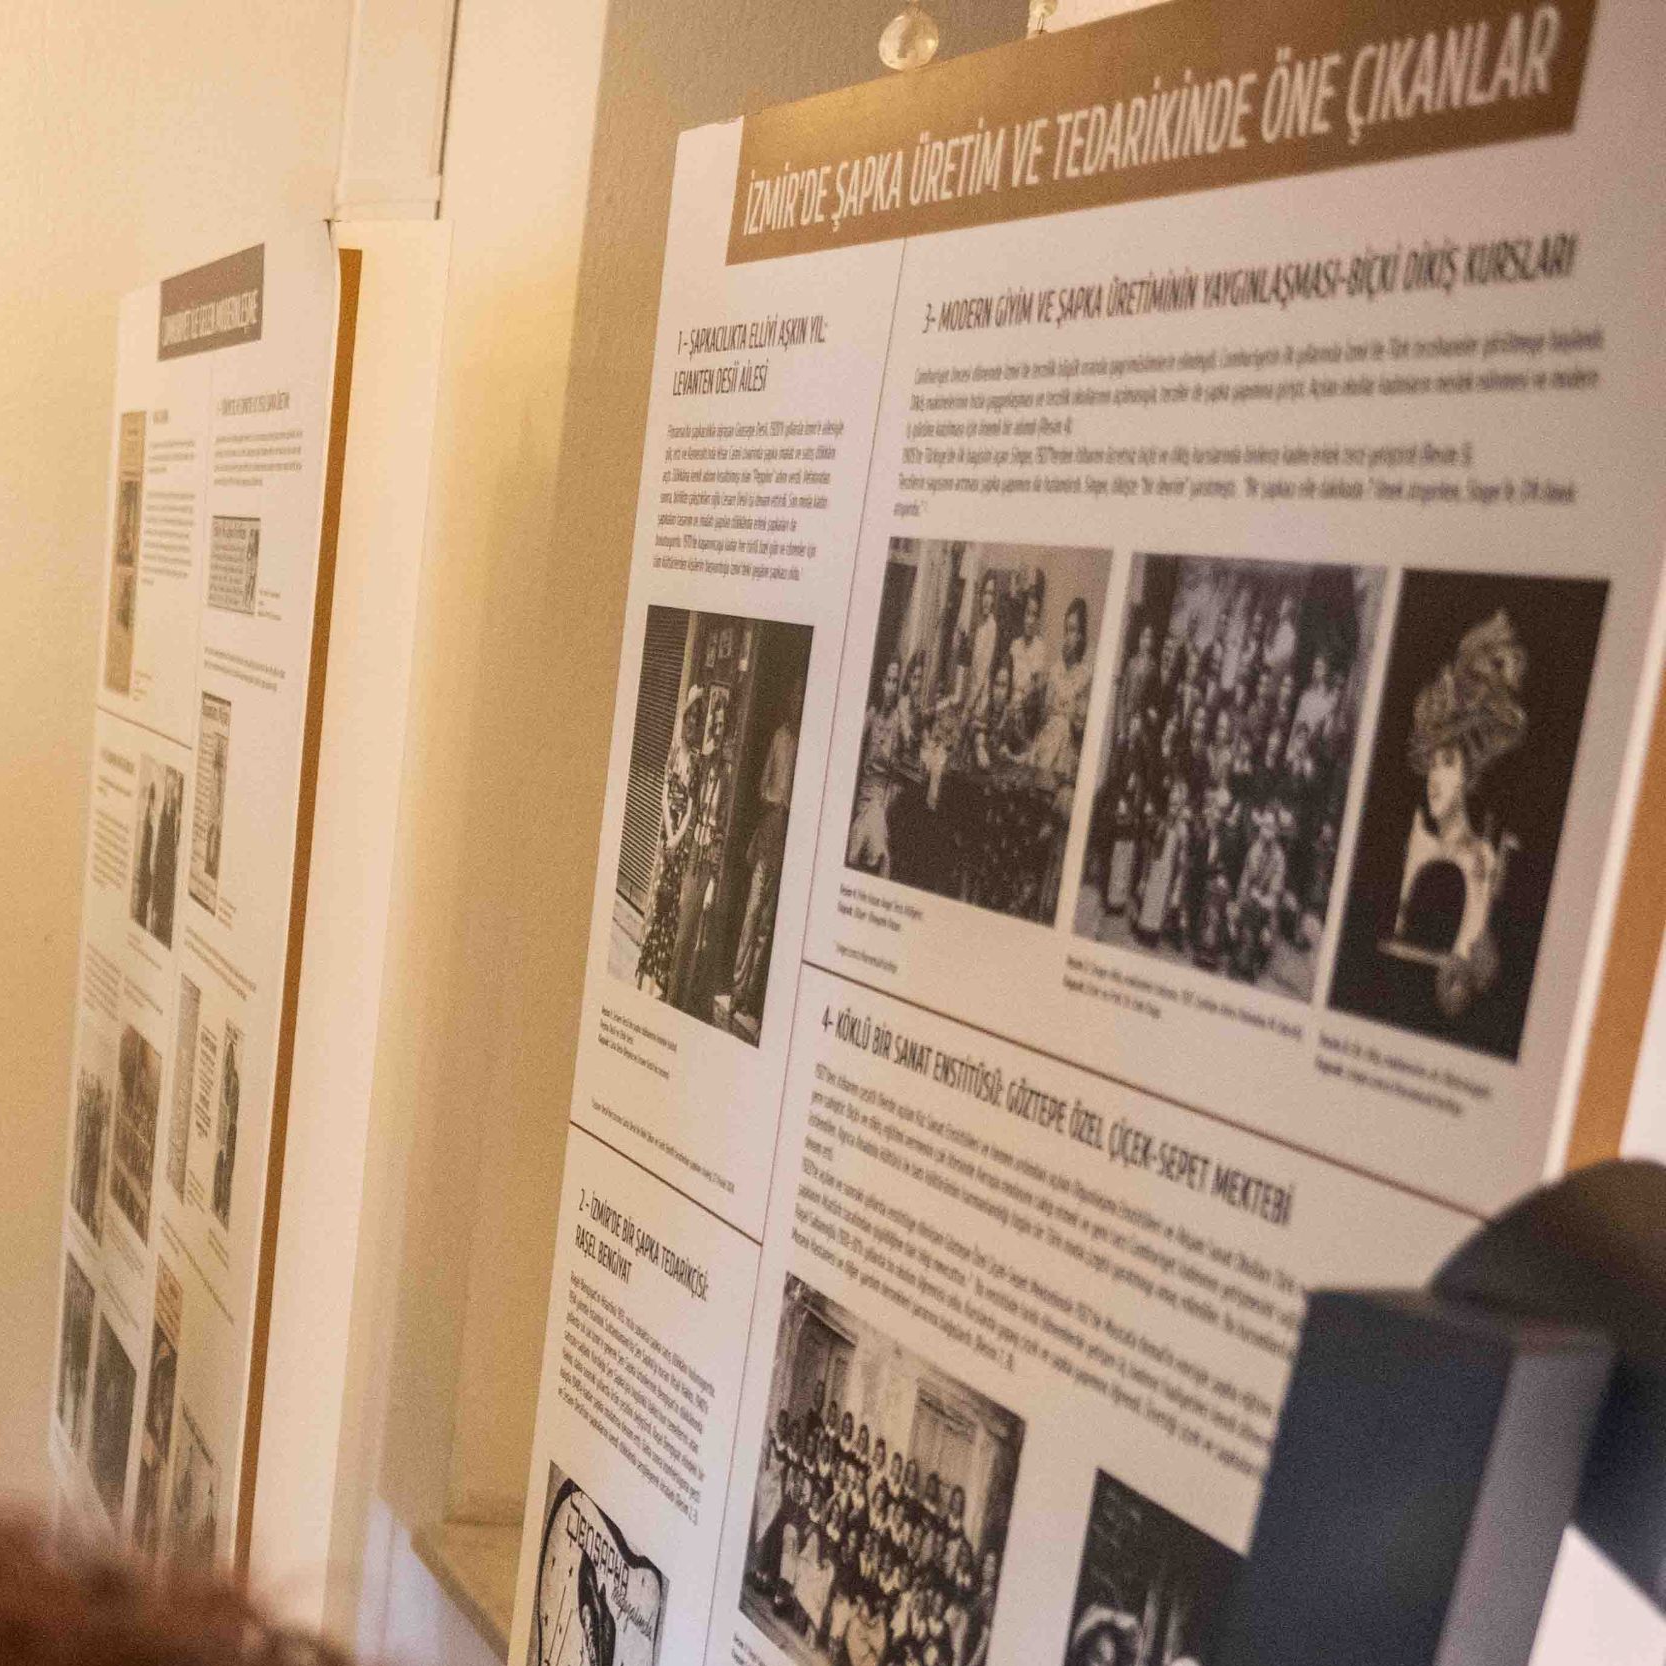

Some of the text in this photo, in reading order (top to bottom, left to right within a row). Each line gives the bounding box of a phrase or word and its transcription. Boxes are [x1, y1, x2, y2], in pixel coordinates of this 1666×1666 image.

[741, 4, 1561, 236] İZMİR'DE ŞAPKA ÜRETİM VE TEDARİKİNDE ÖNE ÇIKANLAR
[937, 296, 993, 333] MODERN
[994, 285, 1033, 328] GİYİM
[1036, 289, 1055, 324] VE
[1055, 283, 1103, 330] ŞAPKA
[1106, 265, 1199, 319] ÜRETİMİNİN
[688, 322, 748, 361] ŞAPKACILIKTA
[748, 311, 779, 350] ELLİYİ
[777, 315, 810, 352] AŞKIN
[672, 366, 715, 396] LEVANTEN
[738, 358, 770, 393] AİLESİ
[835, 1007, 871, 1051] KÖKLÜ
[871, 1022, 892, 1060] BİR
[893, 1034, 933, 1076] SANAT
[1005, 1076, 1067, 1134] GÖZTEPE
[1069, 1099, 1104, 1151] ÖZEL
[574, 1223, 633, 1285] RAŞEL BENGİYAT
[578, 1187, 585, 1212] 2
[590, 1190, 623, 1238] İZMİR'DE
[621, 1215, 635, 1248] BİR
[634, 1228, 660, 1267] ŞAPKA
